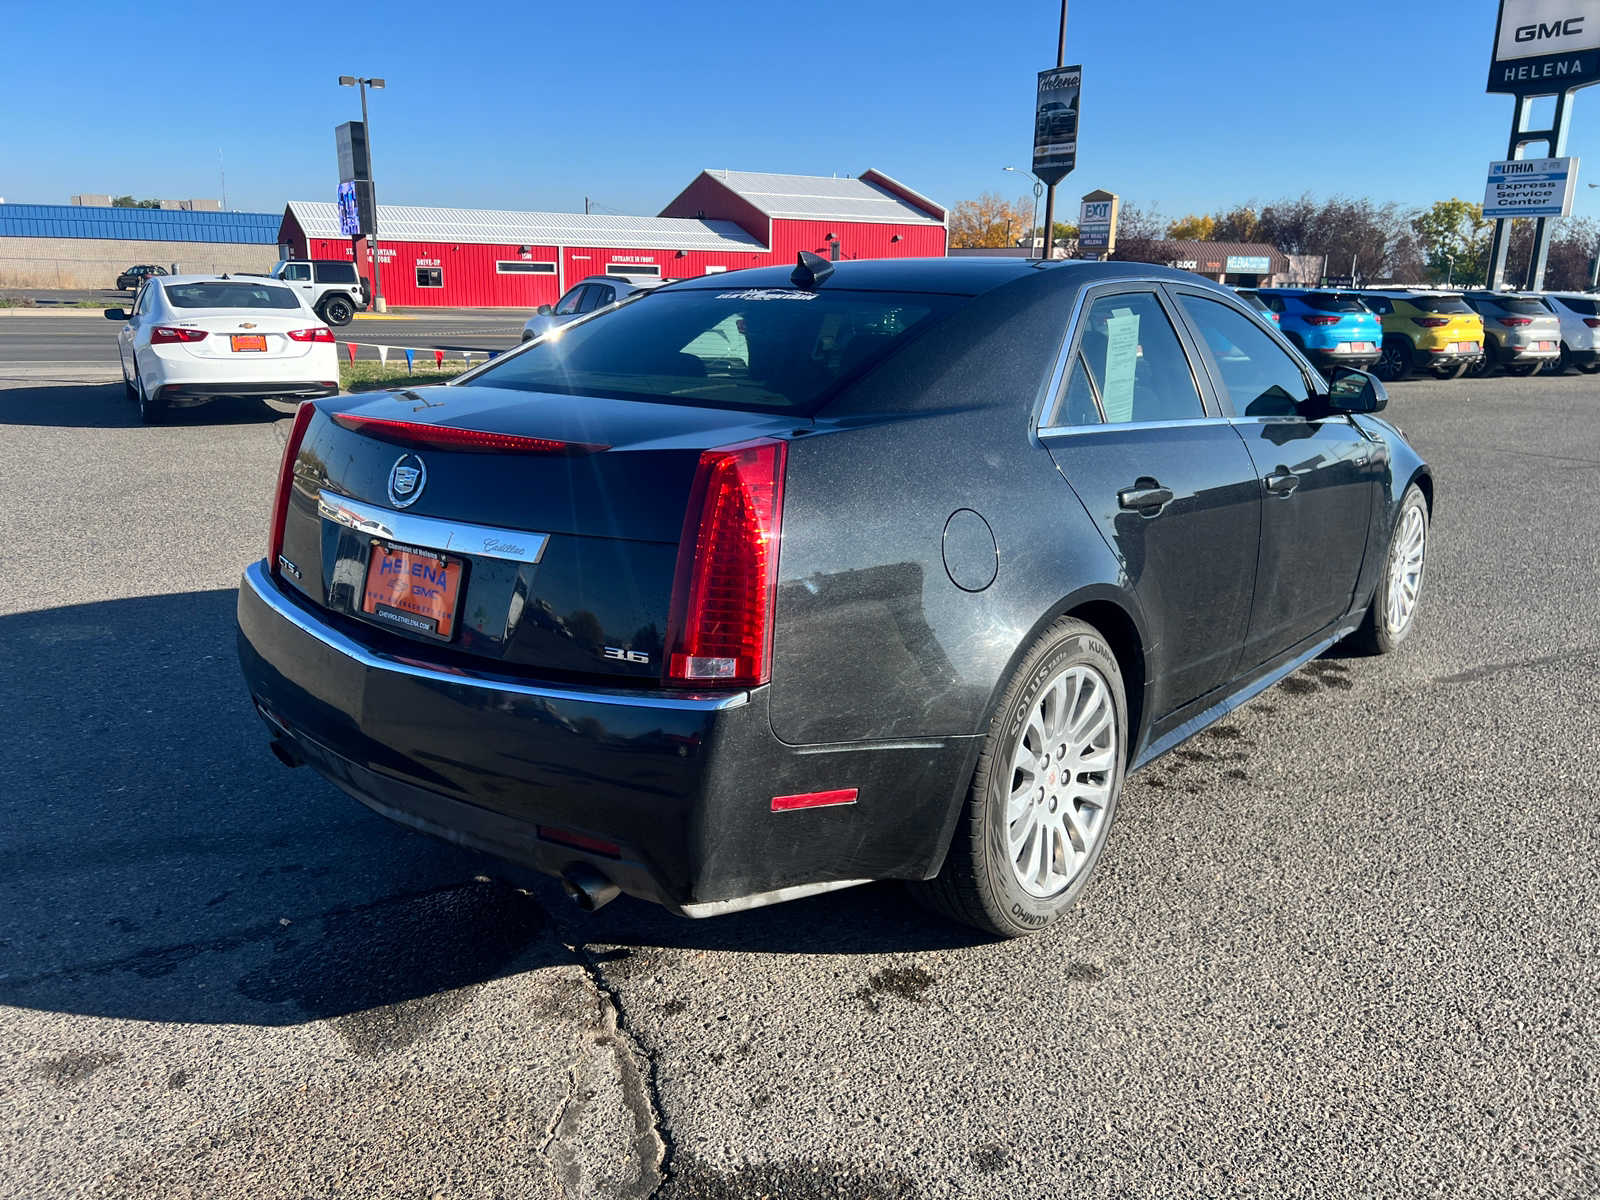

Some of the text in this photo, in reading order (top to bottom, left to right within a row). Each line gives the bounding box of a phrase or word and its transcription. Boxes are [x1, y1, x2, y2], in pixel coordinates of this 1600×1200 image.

[1514, 17, 1585, 43] GMC
[1504, 60, 1582, 81] HELENA
[1039, 74, 1080, 92] Helena
[1502, 163, 1534, 174] LITHIA
[1496, 182, 1556, 191] Express
[1497, 190, 1553, 199] Service
[1085, 203, 1109, 218] EXIT
[1498, 198, 1550, 206] Center
[483, 537, 526, 555] Cadillac
[380, 557, 446, 592] HELENA
[411, 585, 440, 599] GMC
[1088, 640, 1117, 673] KUMHO
[1010, 665, 1050, 737] SOLUS
[1011, 902, 1049, 925] KUMHO
